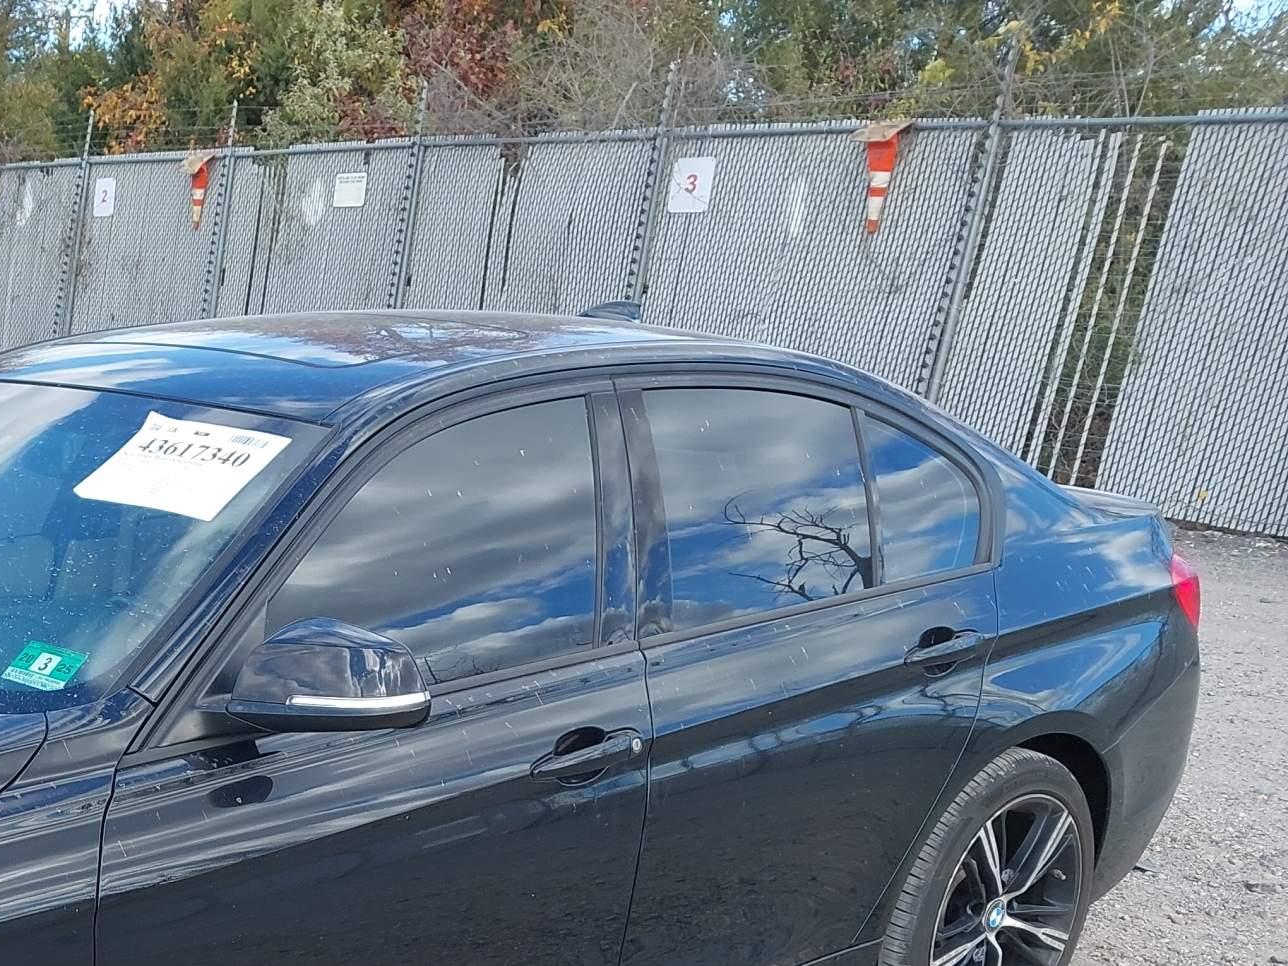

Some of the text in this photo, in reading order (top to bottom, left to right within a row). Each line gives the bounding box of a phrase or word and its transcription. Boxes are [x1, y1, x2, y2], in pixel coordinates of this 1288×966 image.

[685, 174, 698, 194] 3
[101, 190, 108, 203] 2
[138, 438, 251, 468] 43617340
[38, 657, 53, 671] 3
